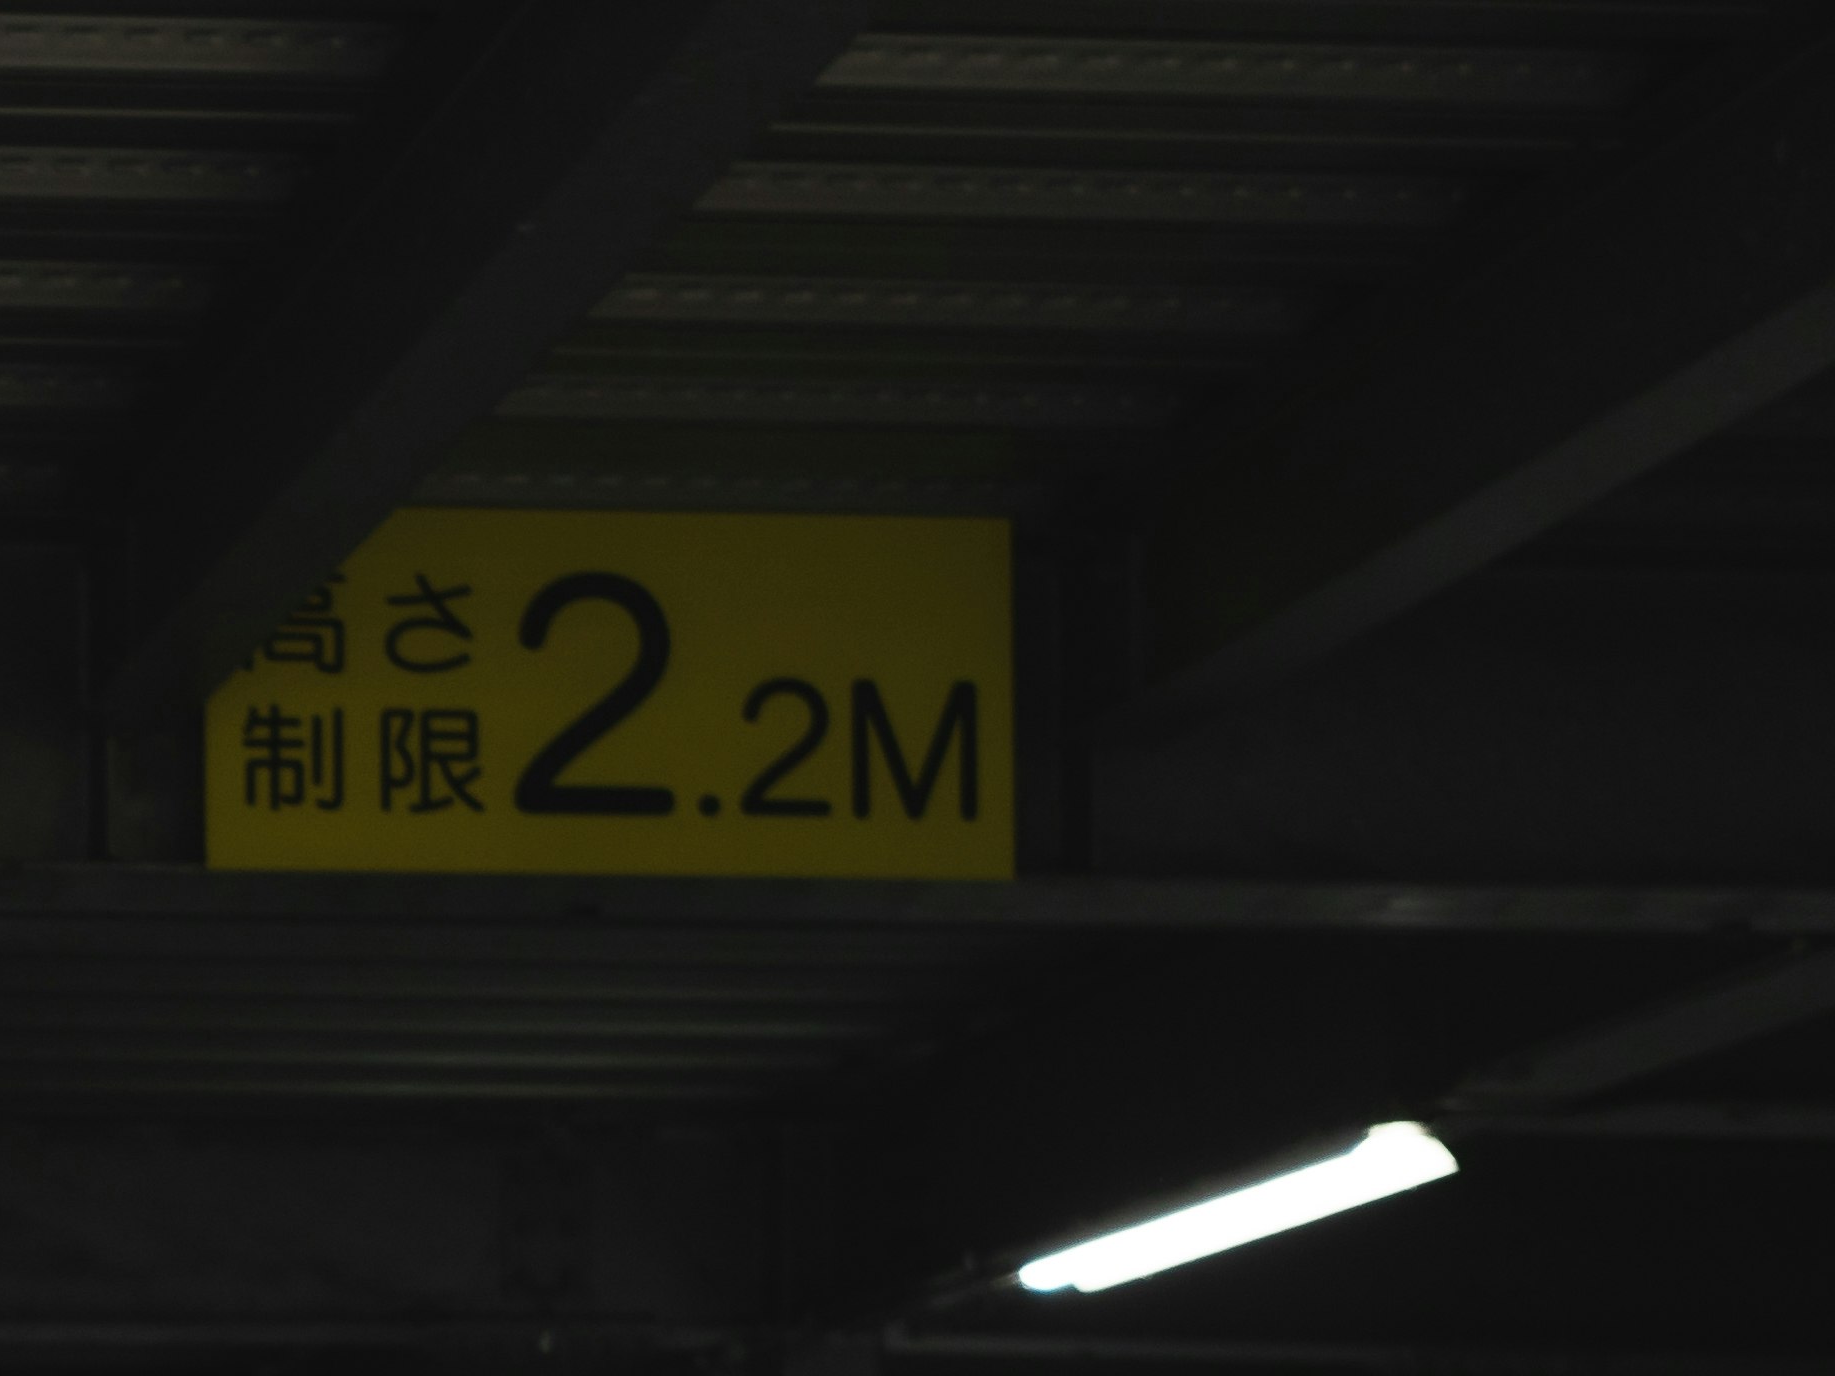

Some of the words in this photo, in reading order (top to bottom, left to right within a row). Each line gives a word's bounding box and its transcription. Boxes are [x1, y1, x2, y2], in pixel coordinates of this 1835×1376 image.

[243, 571, 473, 675] 高さ
[513, 570, 978, 821] 2.2M
[243, 704, 486, 812] 制限
